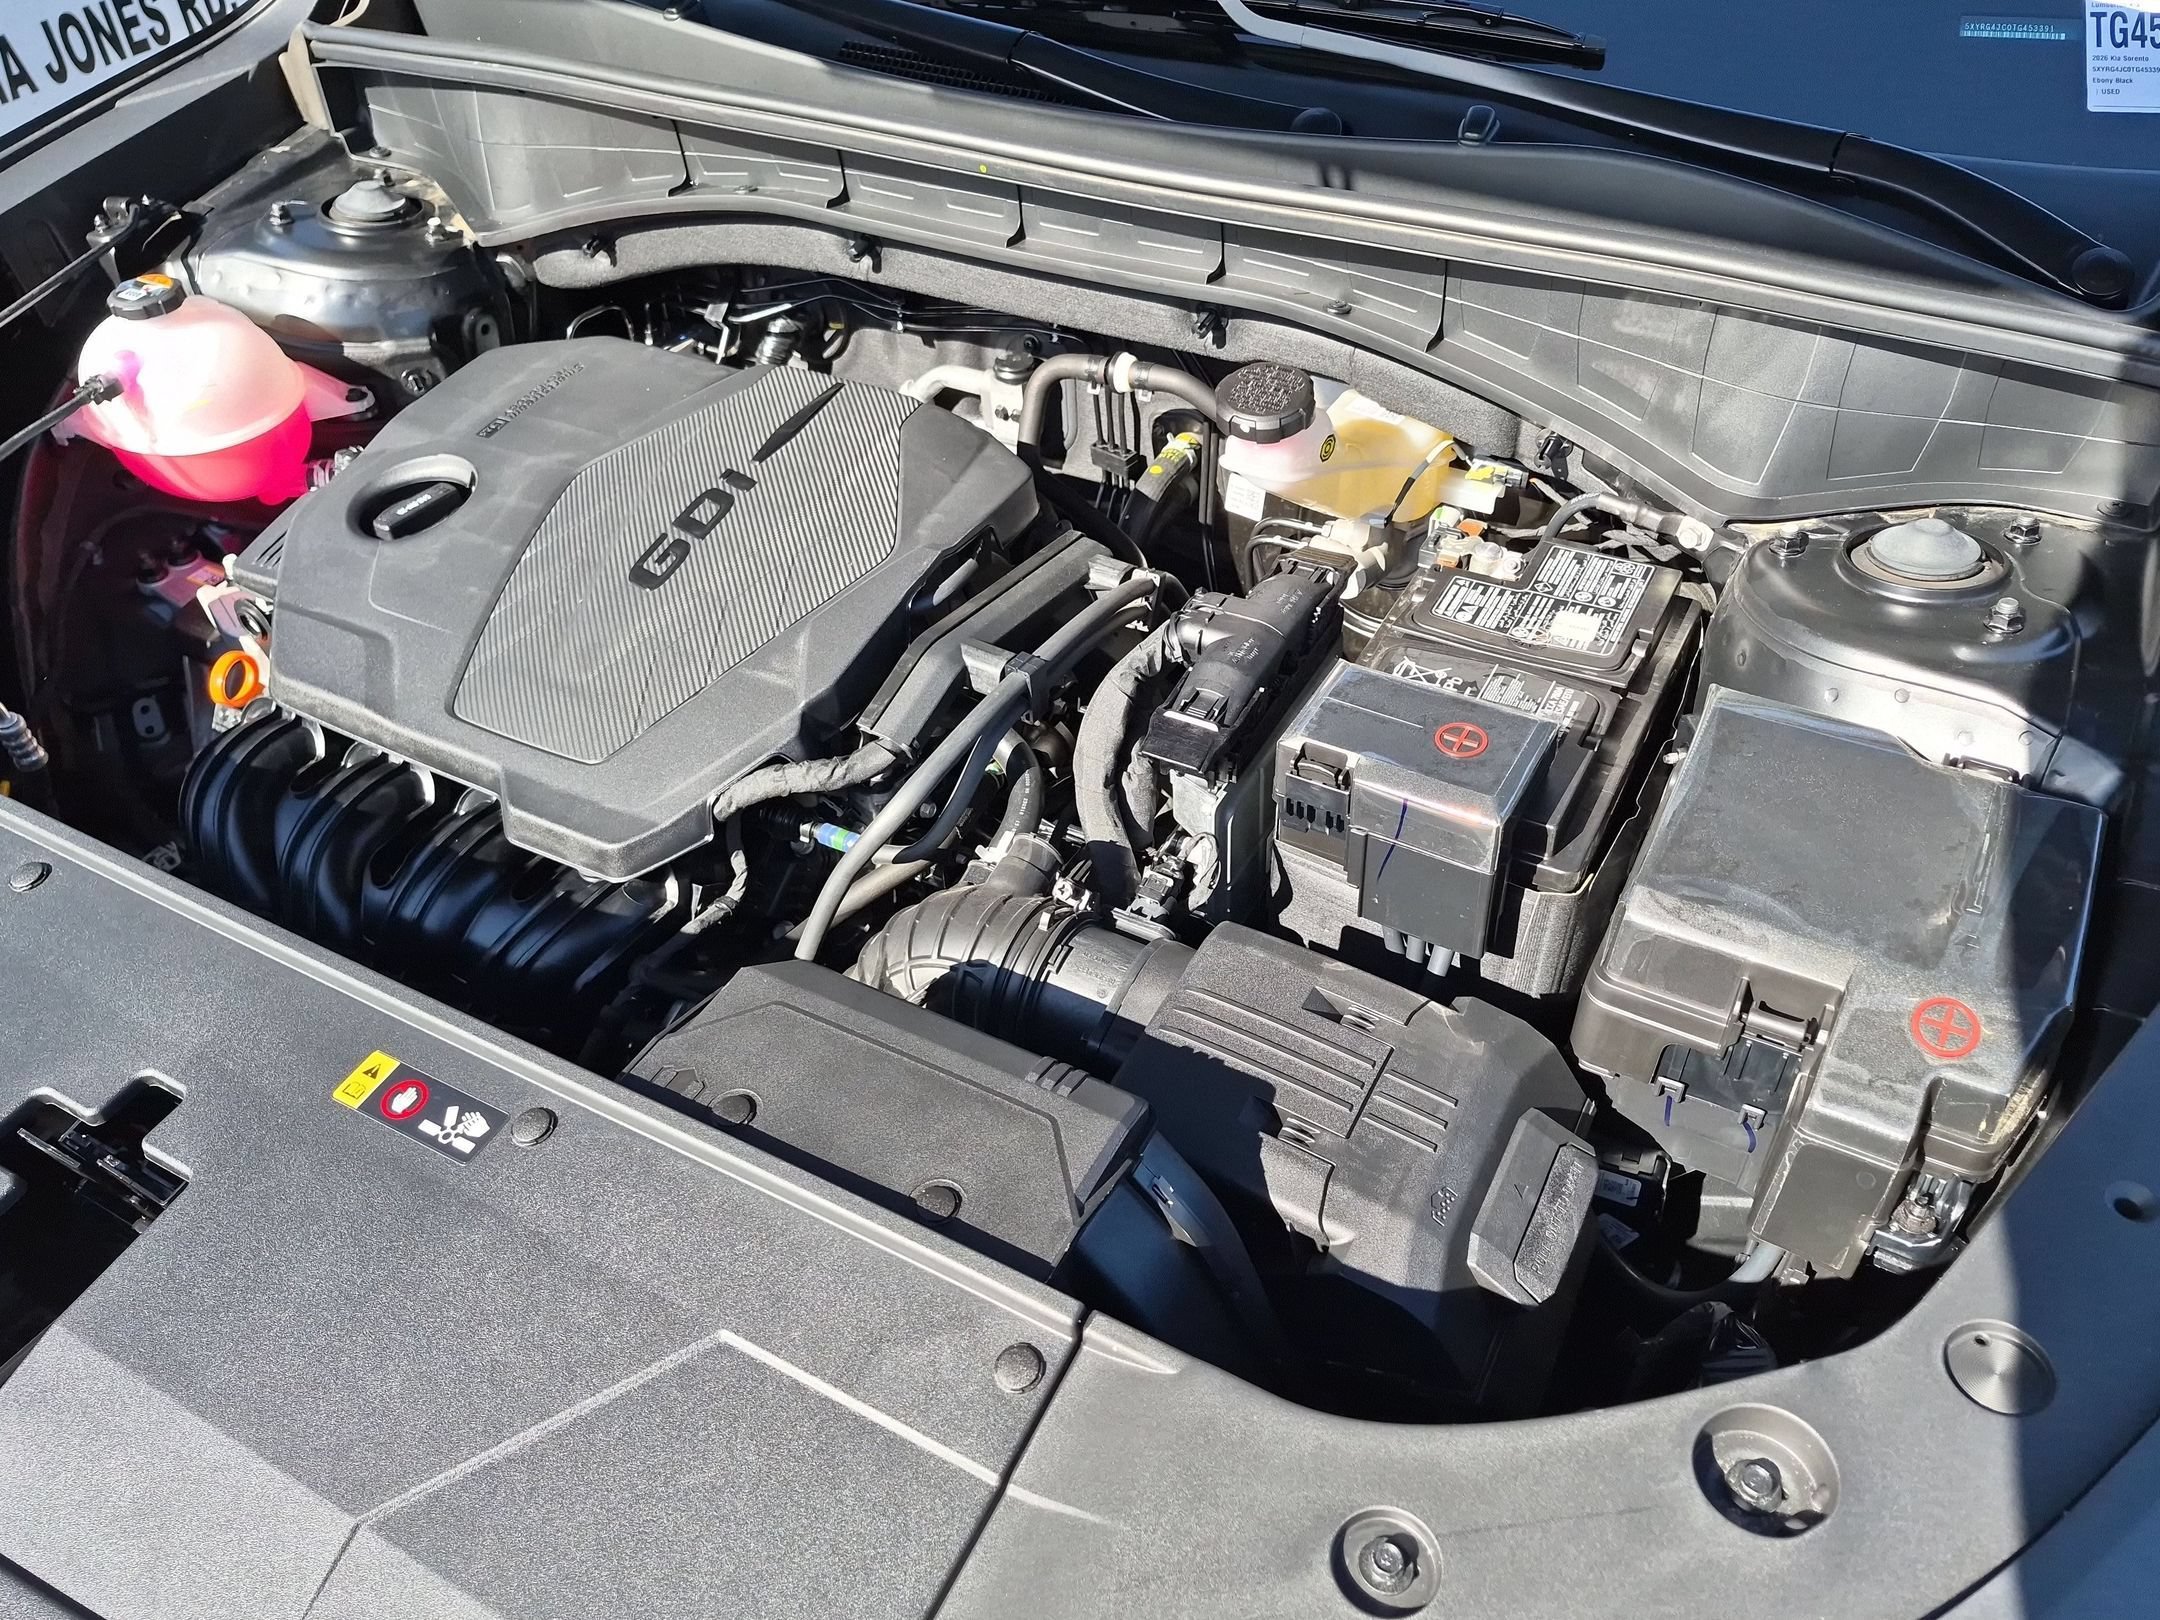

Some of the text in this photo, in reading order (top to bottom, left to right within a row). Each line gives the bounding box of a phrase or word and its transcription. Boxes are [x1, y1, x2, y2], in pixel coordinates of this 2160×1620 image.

[0, 34, 39, 104] A
[41, 0, 170, 84] JONES
[2089, 10, 2160, 49] TG45
[2092, 54, 2109, 62] 2026
[628, 468, 758, 591] GDI
